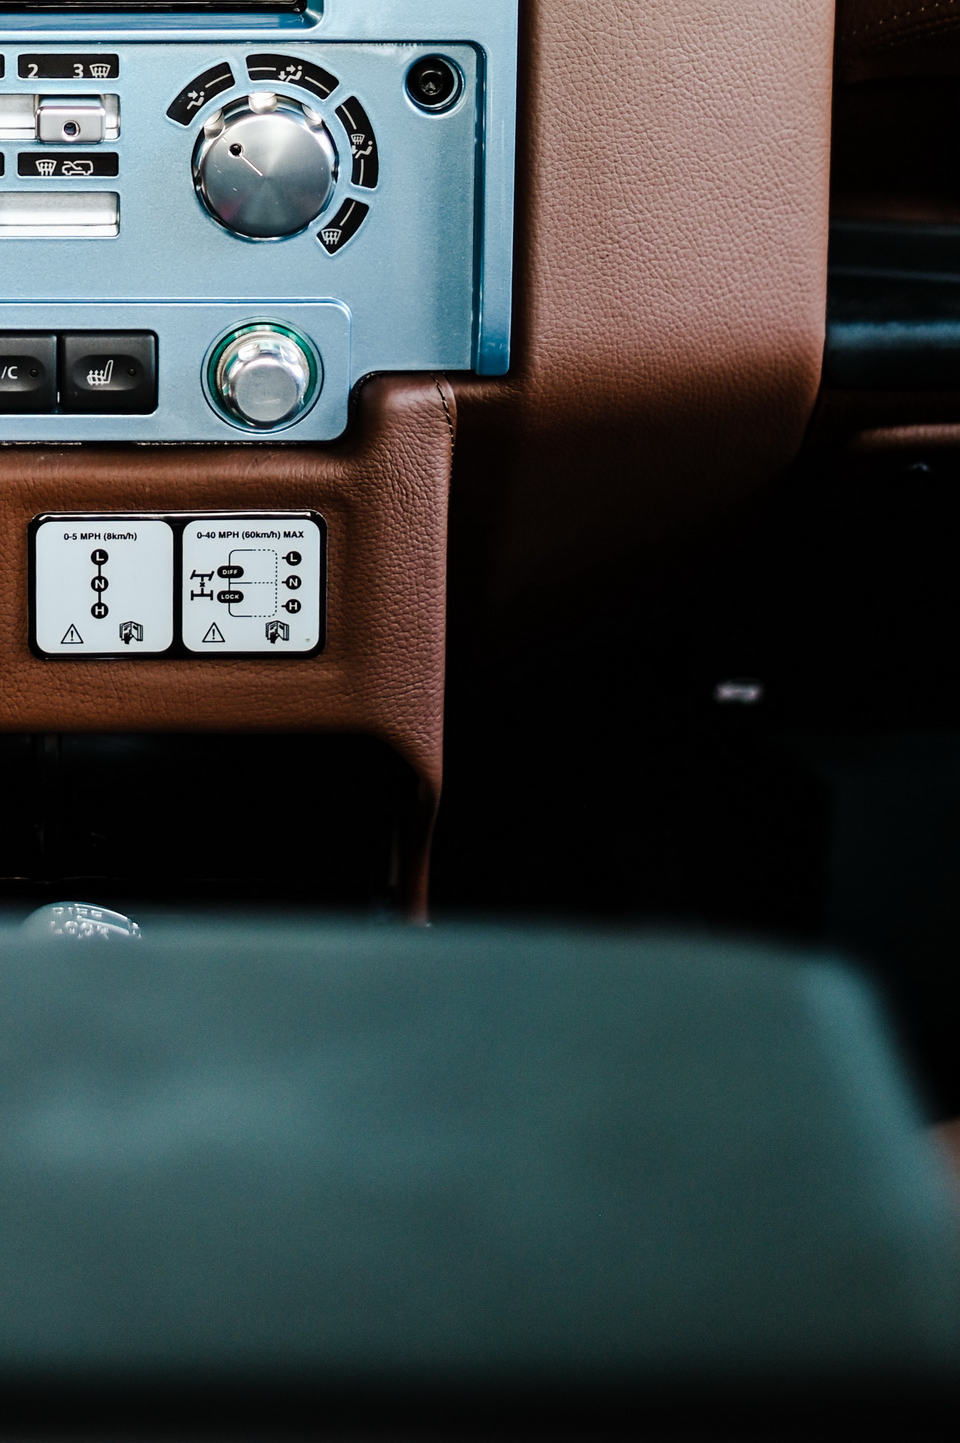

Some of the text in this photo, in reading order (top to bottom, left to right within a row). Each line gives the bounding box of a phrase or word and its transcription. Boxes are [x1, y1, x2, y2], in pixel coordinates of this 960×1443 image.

[27, 63, 84, 79] 2 3
[63, 532, 138, 542] 0-5 MPH (8km/h)
[196, 530, 304, 540] 0-40 MPH (60km/h) MAX
[96, 551, 105, 562] L
[290, 553, 298, 562] L
[95, 579, 105, 589] N
[289, 578, 298, 587] N
[289, 601, 298, 610] H
[95, 606, 105, 616] H
